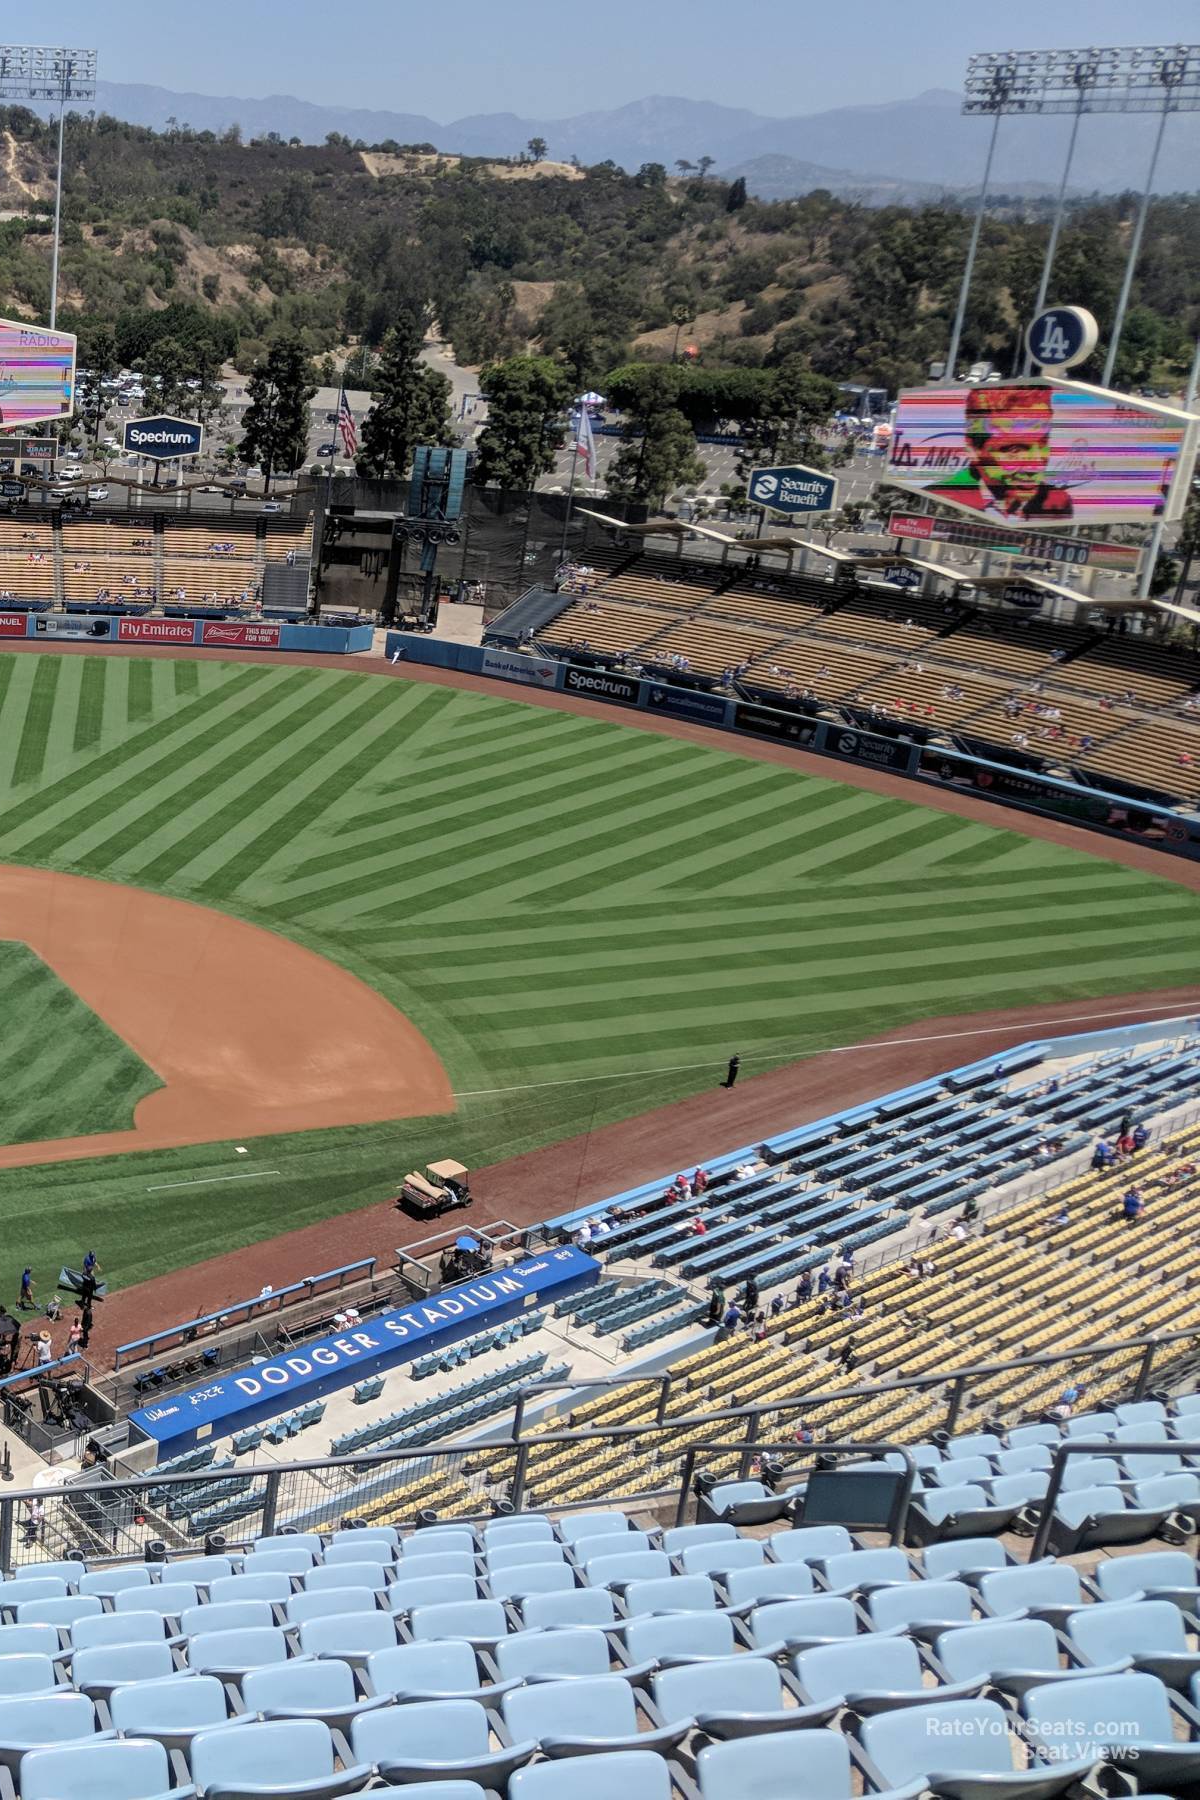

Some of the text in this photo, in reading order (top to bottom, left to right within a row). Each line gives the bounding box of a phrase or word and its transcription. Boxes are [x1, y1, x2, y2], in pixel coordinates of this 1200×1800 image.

[19, 336, 60, 346] RADIO
[1042, 316, 1069, 359] LA
[130, 429, 191, 445] Spectrum
[781, 477, 828, 494] Security
[780, 491, 818, 507] Benefit
[893, 523, 929, 535] Emirates
[900, 568, 919, 584] BEAM
[121, 623, 193, 637] Fly Emirates
[485, 659, 501, 669] Bank
[509, 664, 536, 676] America
[568, 671, 632, 697] Spectrum
[860, 737, 896, 756] Security
[858, 748, 889, 763] Benefit
[234, 1275, 523, 1396] DODGER STADIUM
[189, 1385, 224, 1405] ようこそ
[144, 1406, 180, 1421] Welcome
